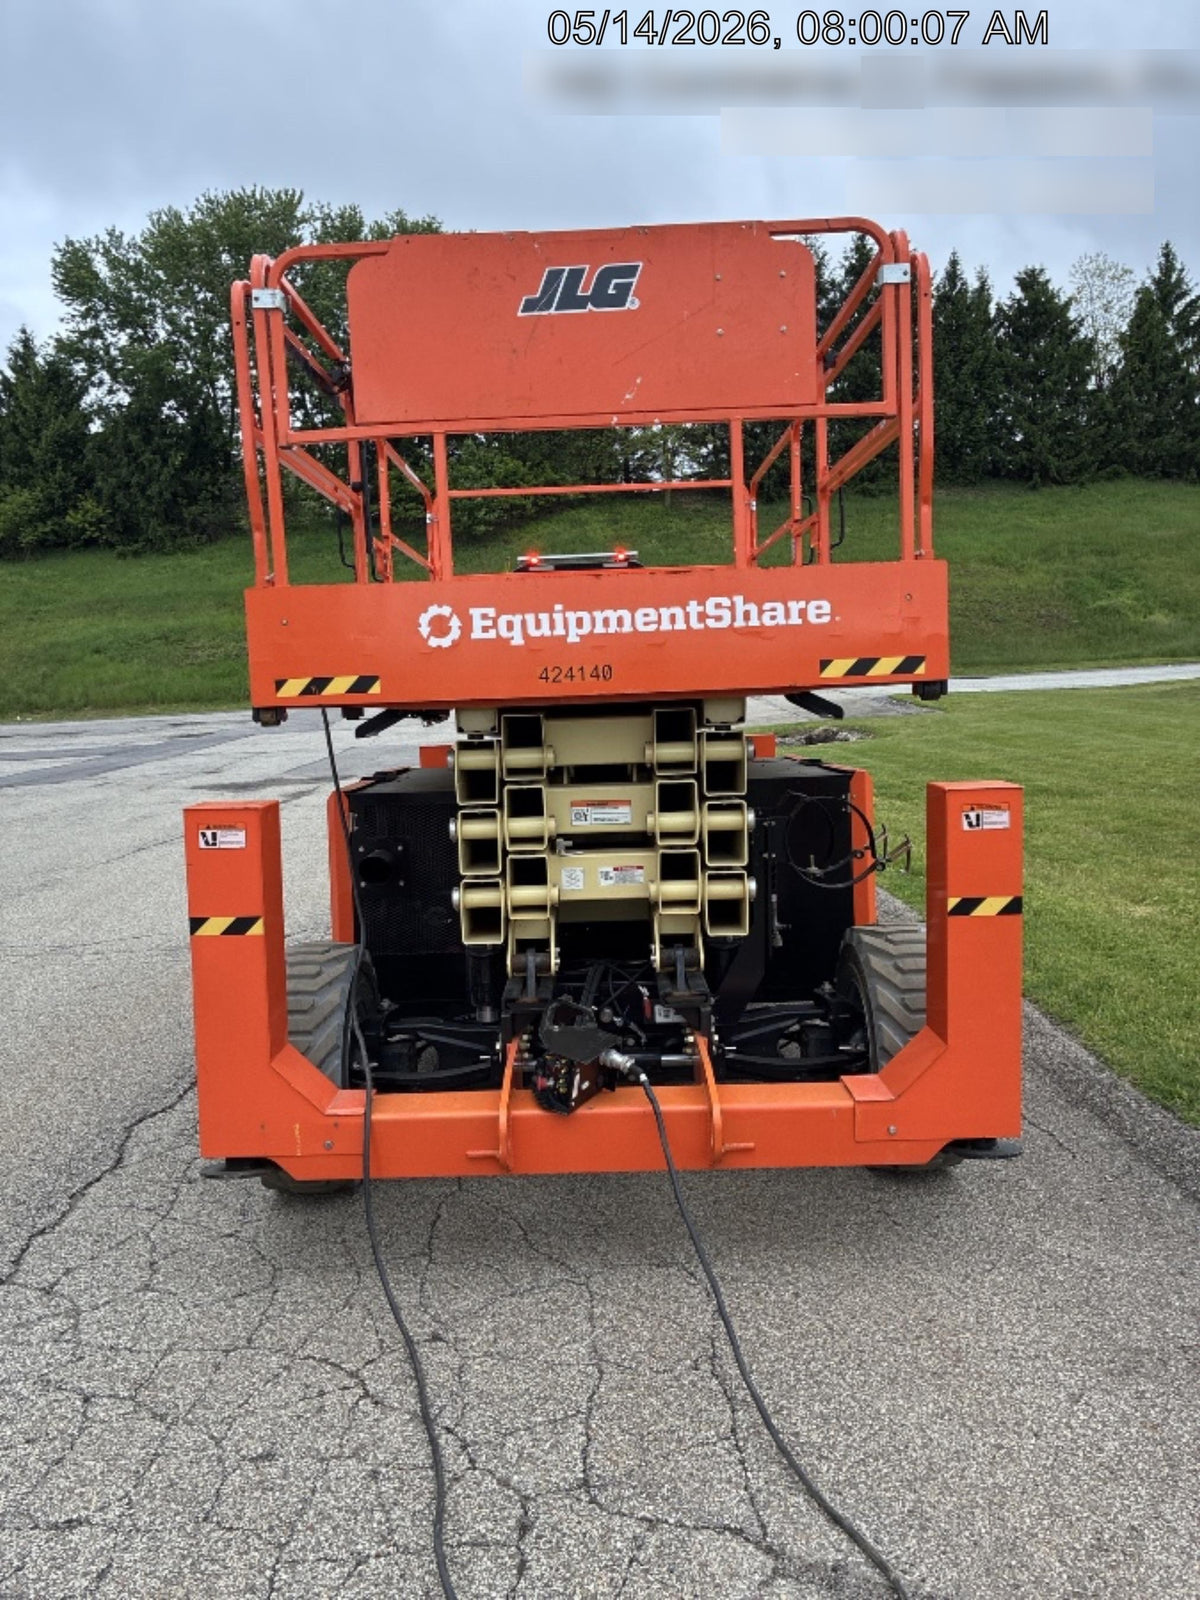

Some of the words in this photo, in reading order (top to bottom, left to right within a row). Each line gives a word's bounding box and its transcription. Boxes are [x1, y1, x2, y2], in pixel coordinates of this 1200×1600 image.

[517, 262, 642, 317] JLG
[469, 595, 831, 646] EquipmentShare
[538, 664, 612, 683] 424140
